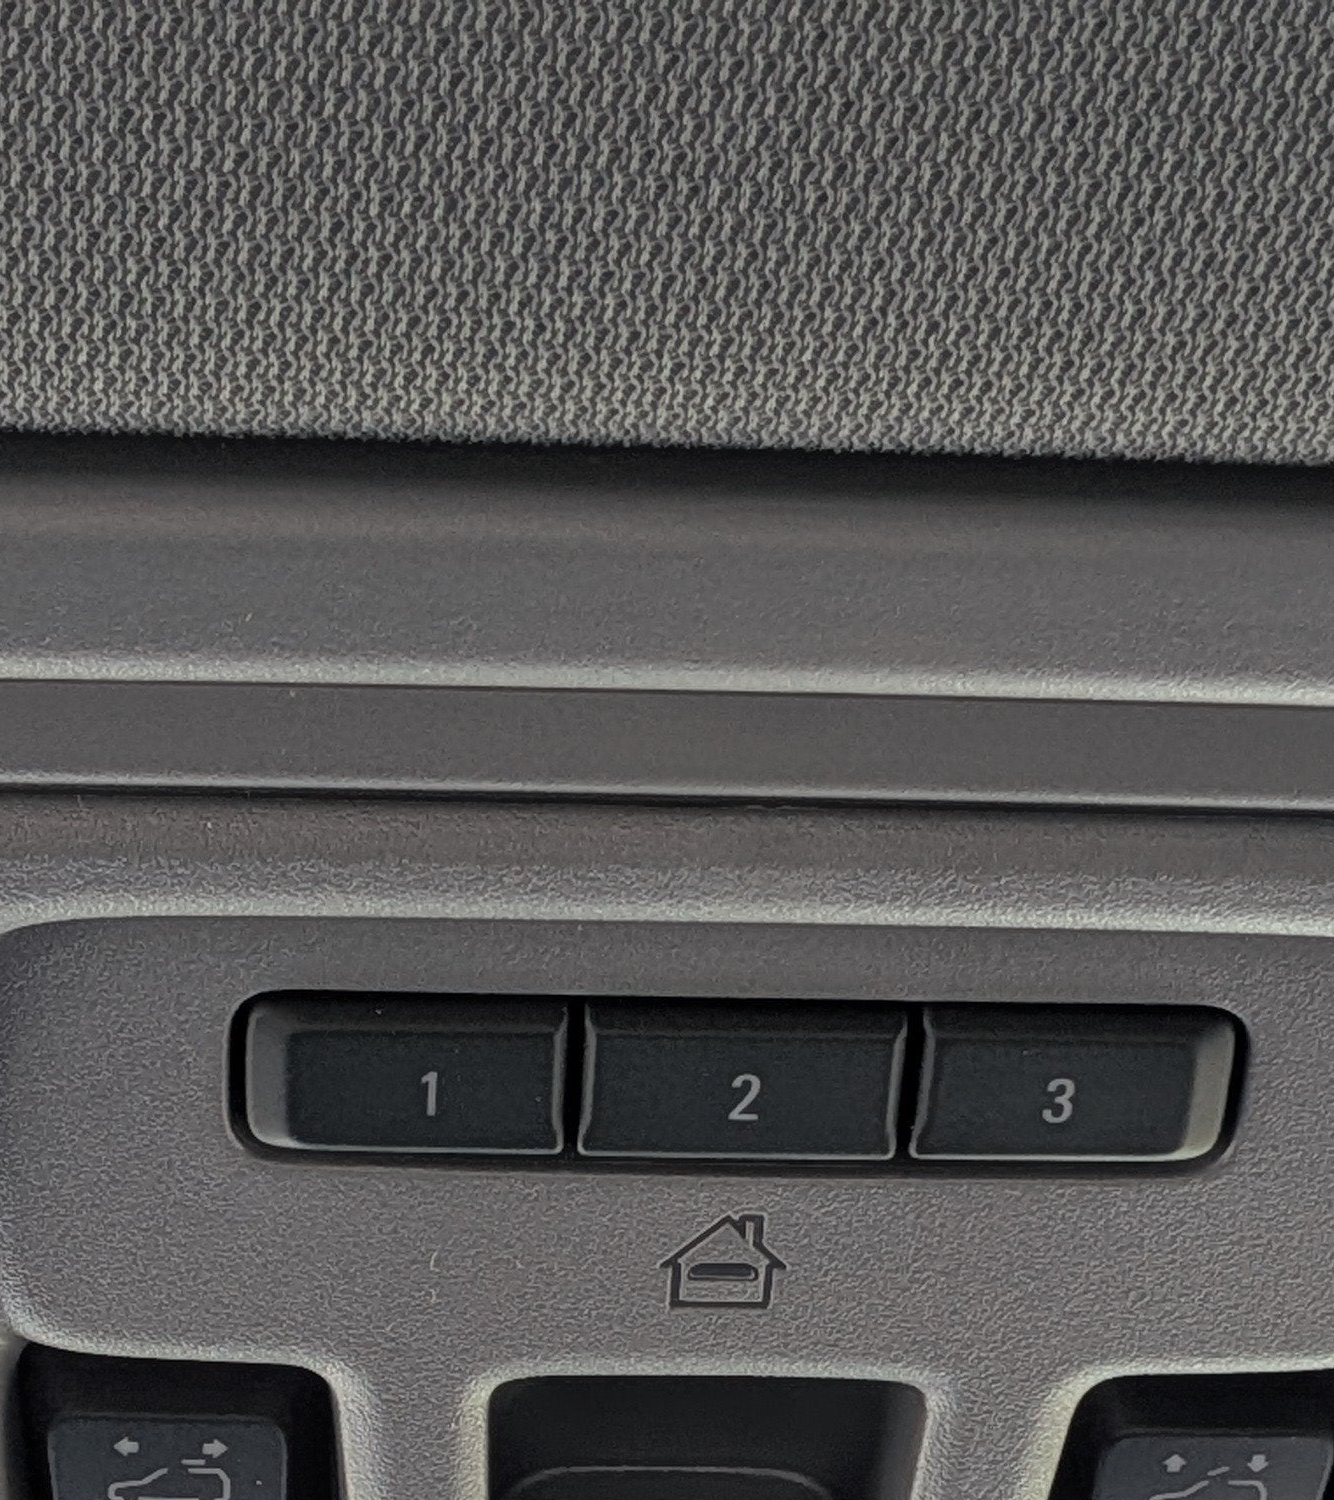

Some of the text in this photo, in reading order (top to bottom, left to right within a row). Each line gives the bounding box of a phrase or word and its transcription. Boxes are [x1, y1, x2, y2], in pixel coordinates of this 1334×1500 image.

[419, 1070, 440, 1117] 1
[728, 1074, 762, 1121] 2
[1041, 1078, 1077, 1125] 3
